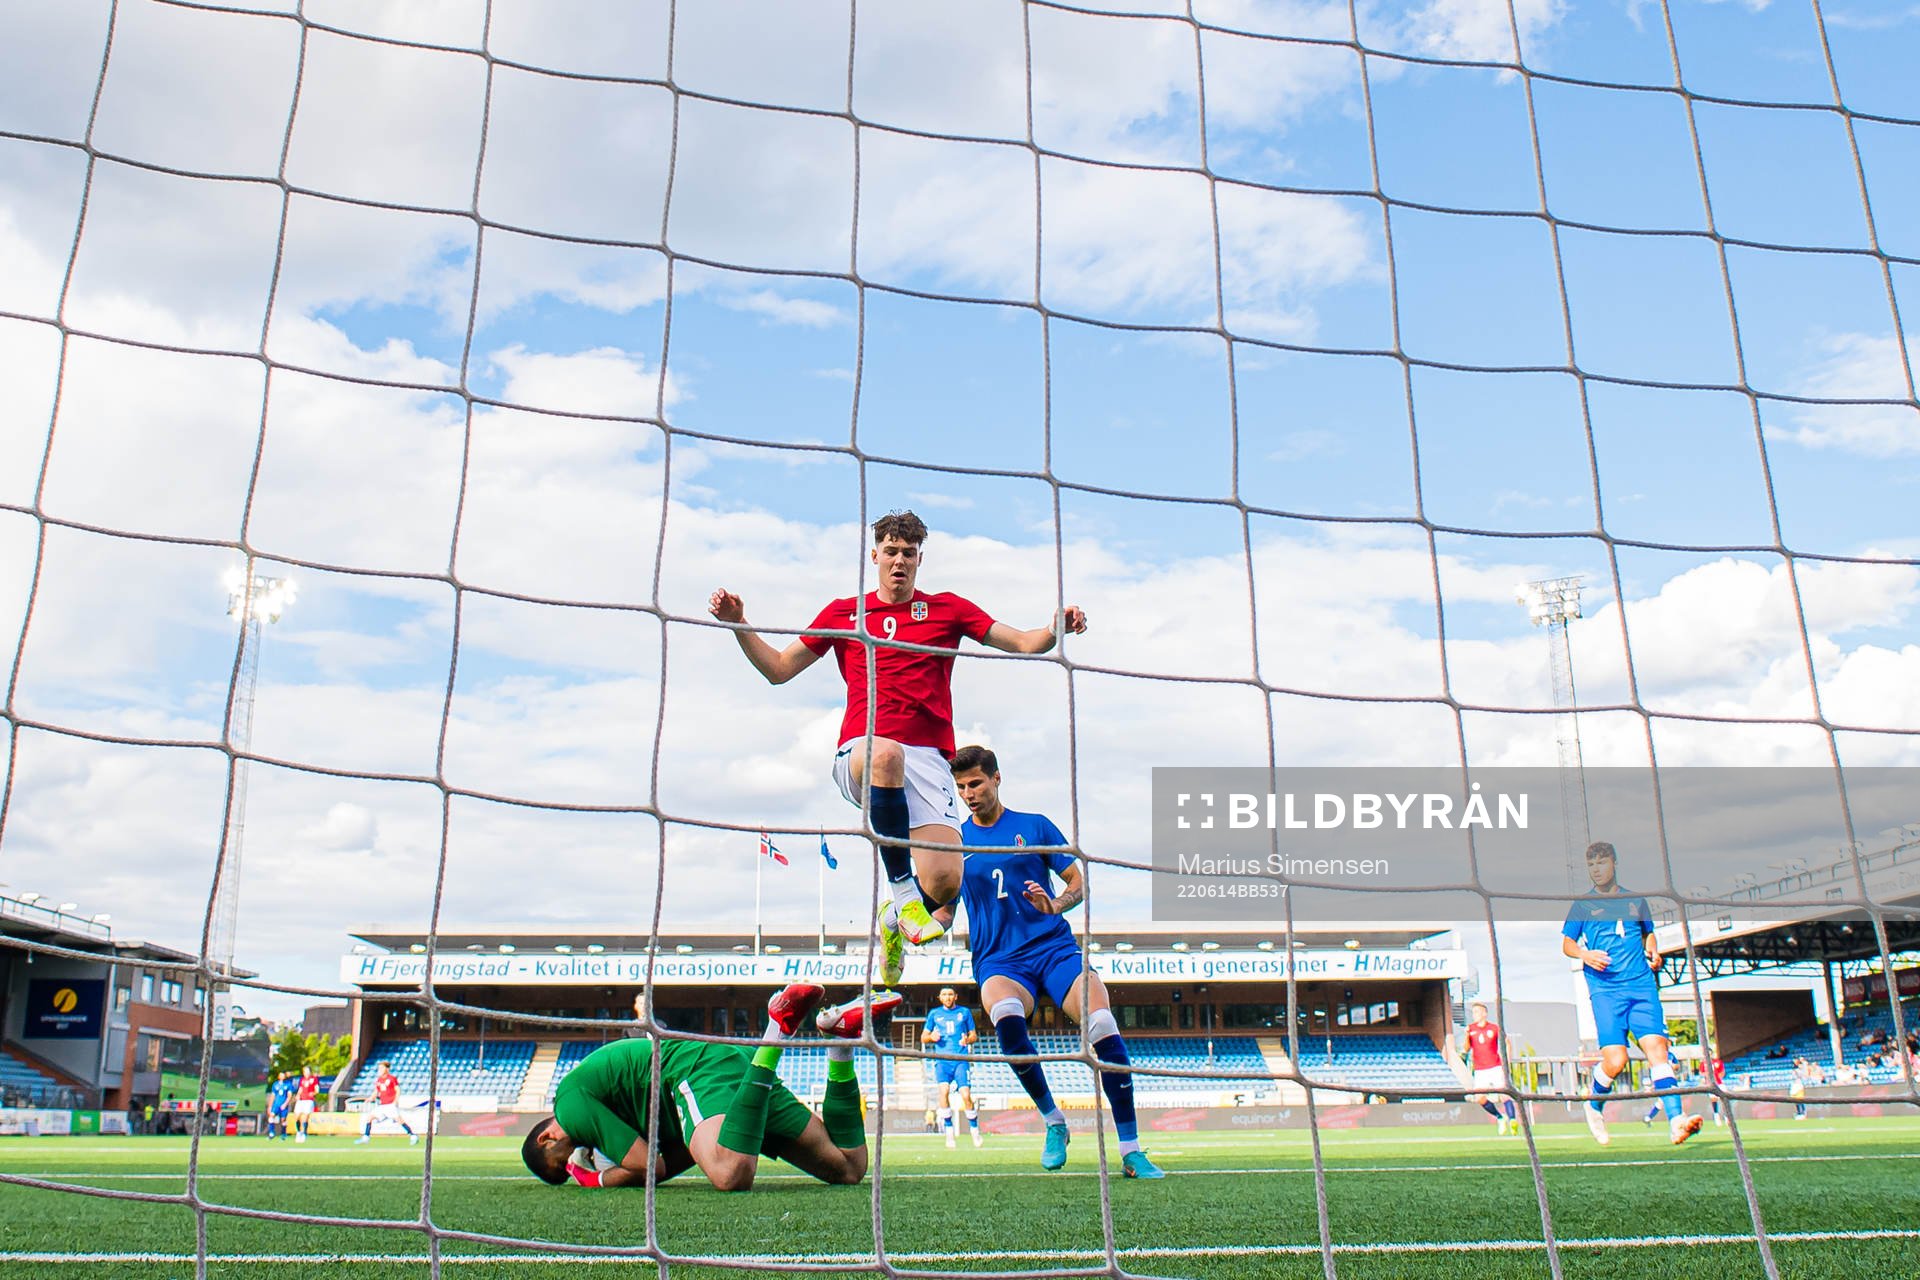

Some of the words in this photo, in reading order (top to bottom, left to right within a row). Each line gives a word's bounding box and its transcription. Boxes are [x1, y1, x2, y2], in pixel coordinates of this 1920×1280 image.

[883, 616, 897, 641] 9
[992, 868, 1008, 899] 2
[536, 957, 610, 976] Kvalitet
[617, 958, 622, 976] i
[1112, 957, 1184, 975] Kvalitet
[1192, 957, 1196, 974] i
[1203, 955, 1328, 978] generasjoner
[1373, 955, 1447, 974] Magnor
